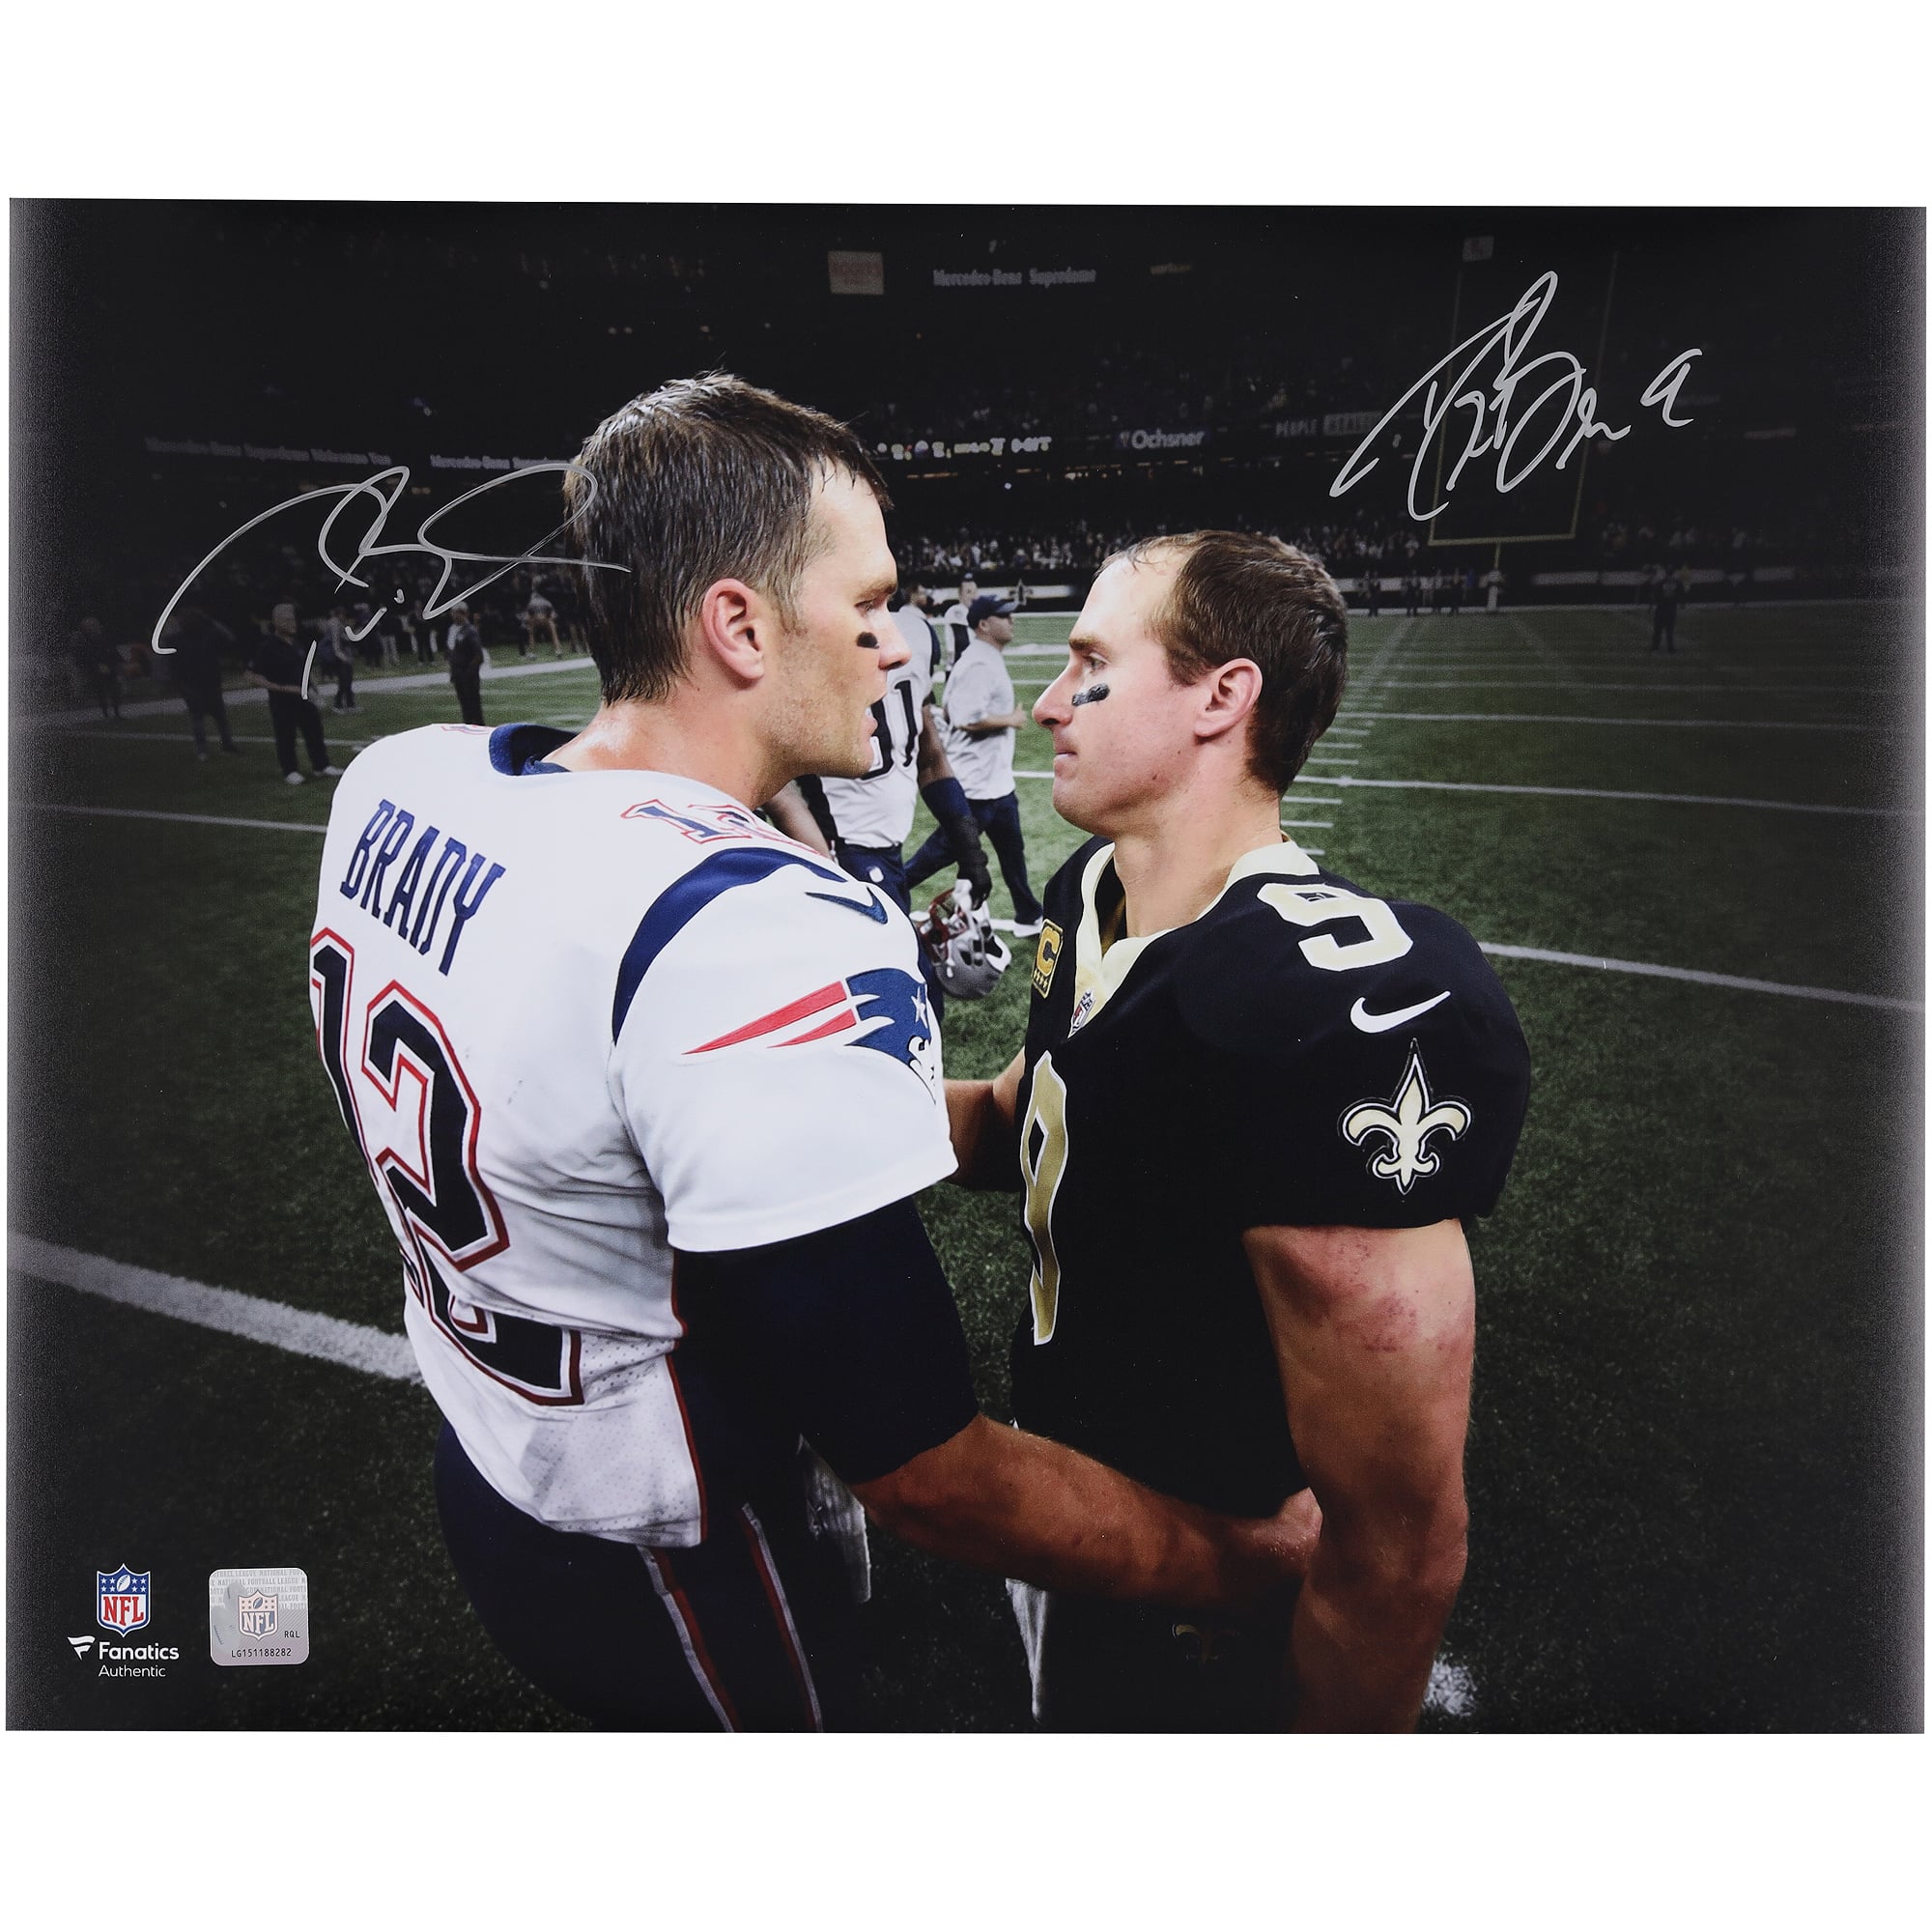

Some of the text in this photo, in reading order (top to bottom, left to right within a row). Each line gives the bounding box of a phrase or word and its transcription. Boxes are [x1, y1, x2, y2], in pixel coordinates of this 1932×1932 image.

[1131, 428, 1206, 449] Ochsner
[340, 799, 506, 976] BRADY
[1257, 882, 1413, 972] 9
[309, 926, 585, 1406] 12
[103, 1596, 144, 1627] NFL
[242, 1612, 274, 1634] NFL
[99, 1641, 180, 1661] Fanatics
[231, 1647, 292, 1658] LG151188282
[98, 1664, 166, 1678] Authentic
